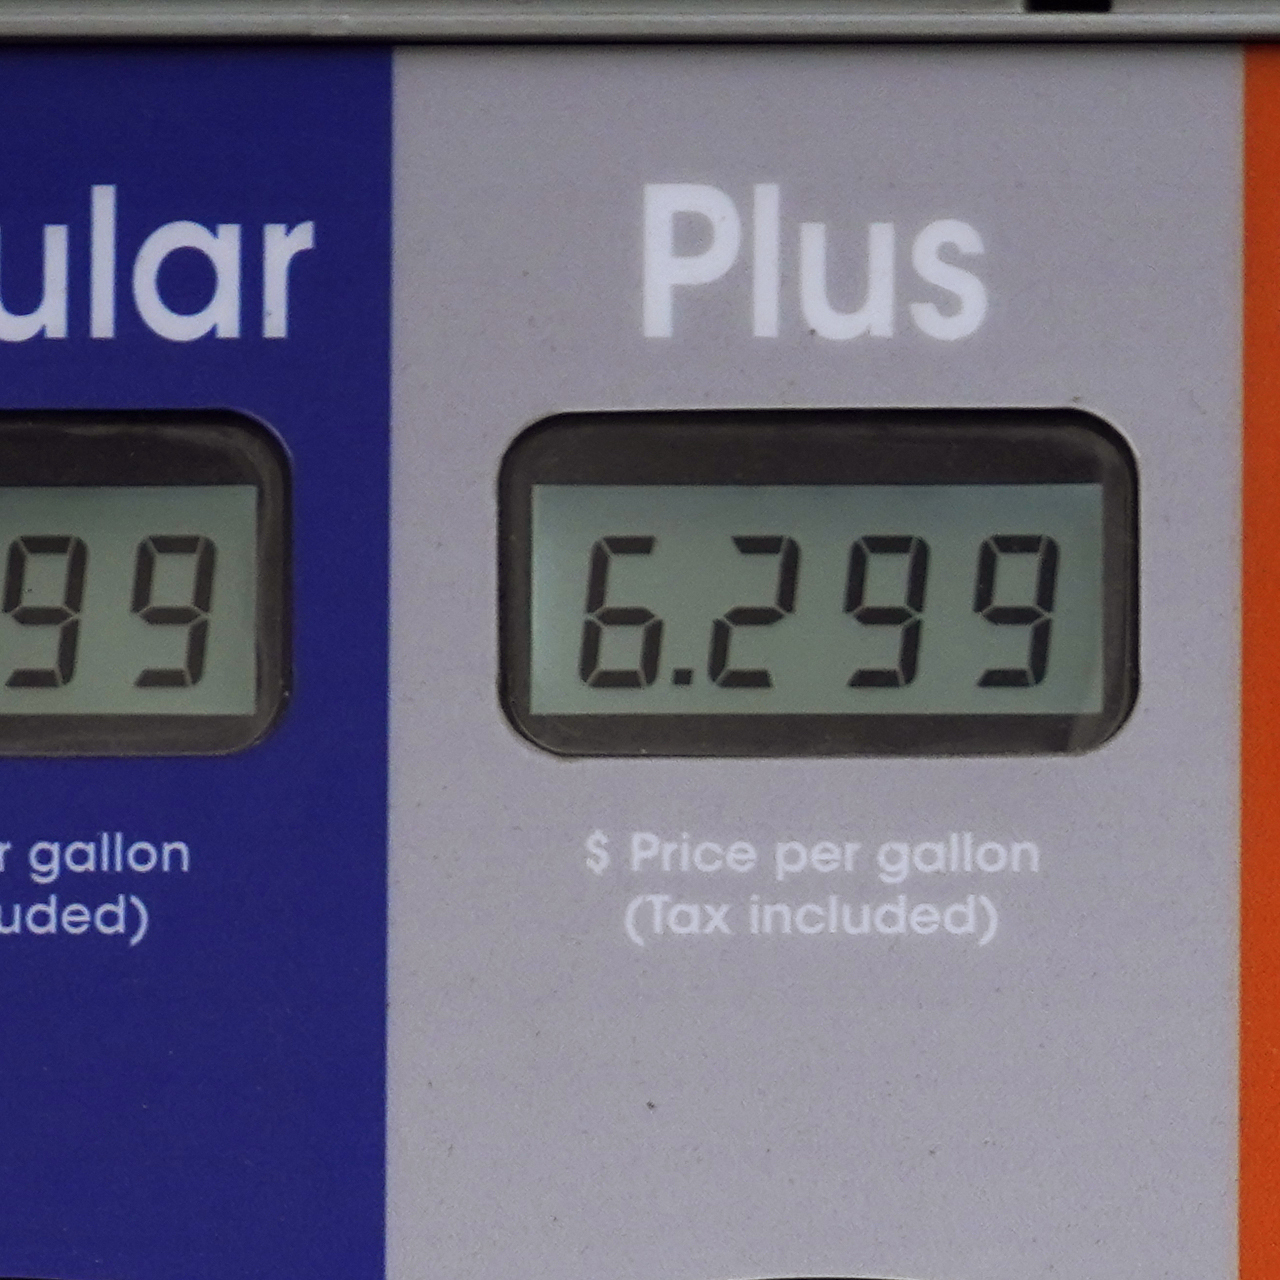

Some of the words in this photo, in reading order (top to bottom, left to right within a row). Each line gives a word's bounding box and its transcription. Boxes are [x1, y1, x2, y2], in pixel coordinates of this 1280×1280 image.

[641, 182, 988, 343] Plus
[579, 533, 1063, 689] 6.299
[29, 830, 190, 883] gallon
[585, 831, 610, 875] $
[631, 833, 758, 873] Price
[775, 838, 862, 882] per
[877, 830, 1040, 882] gallon
[624, 895, 731, 947] (Tax
[750, 895, 999, 944] included)
